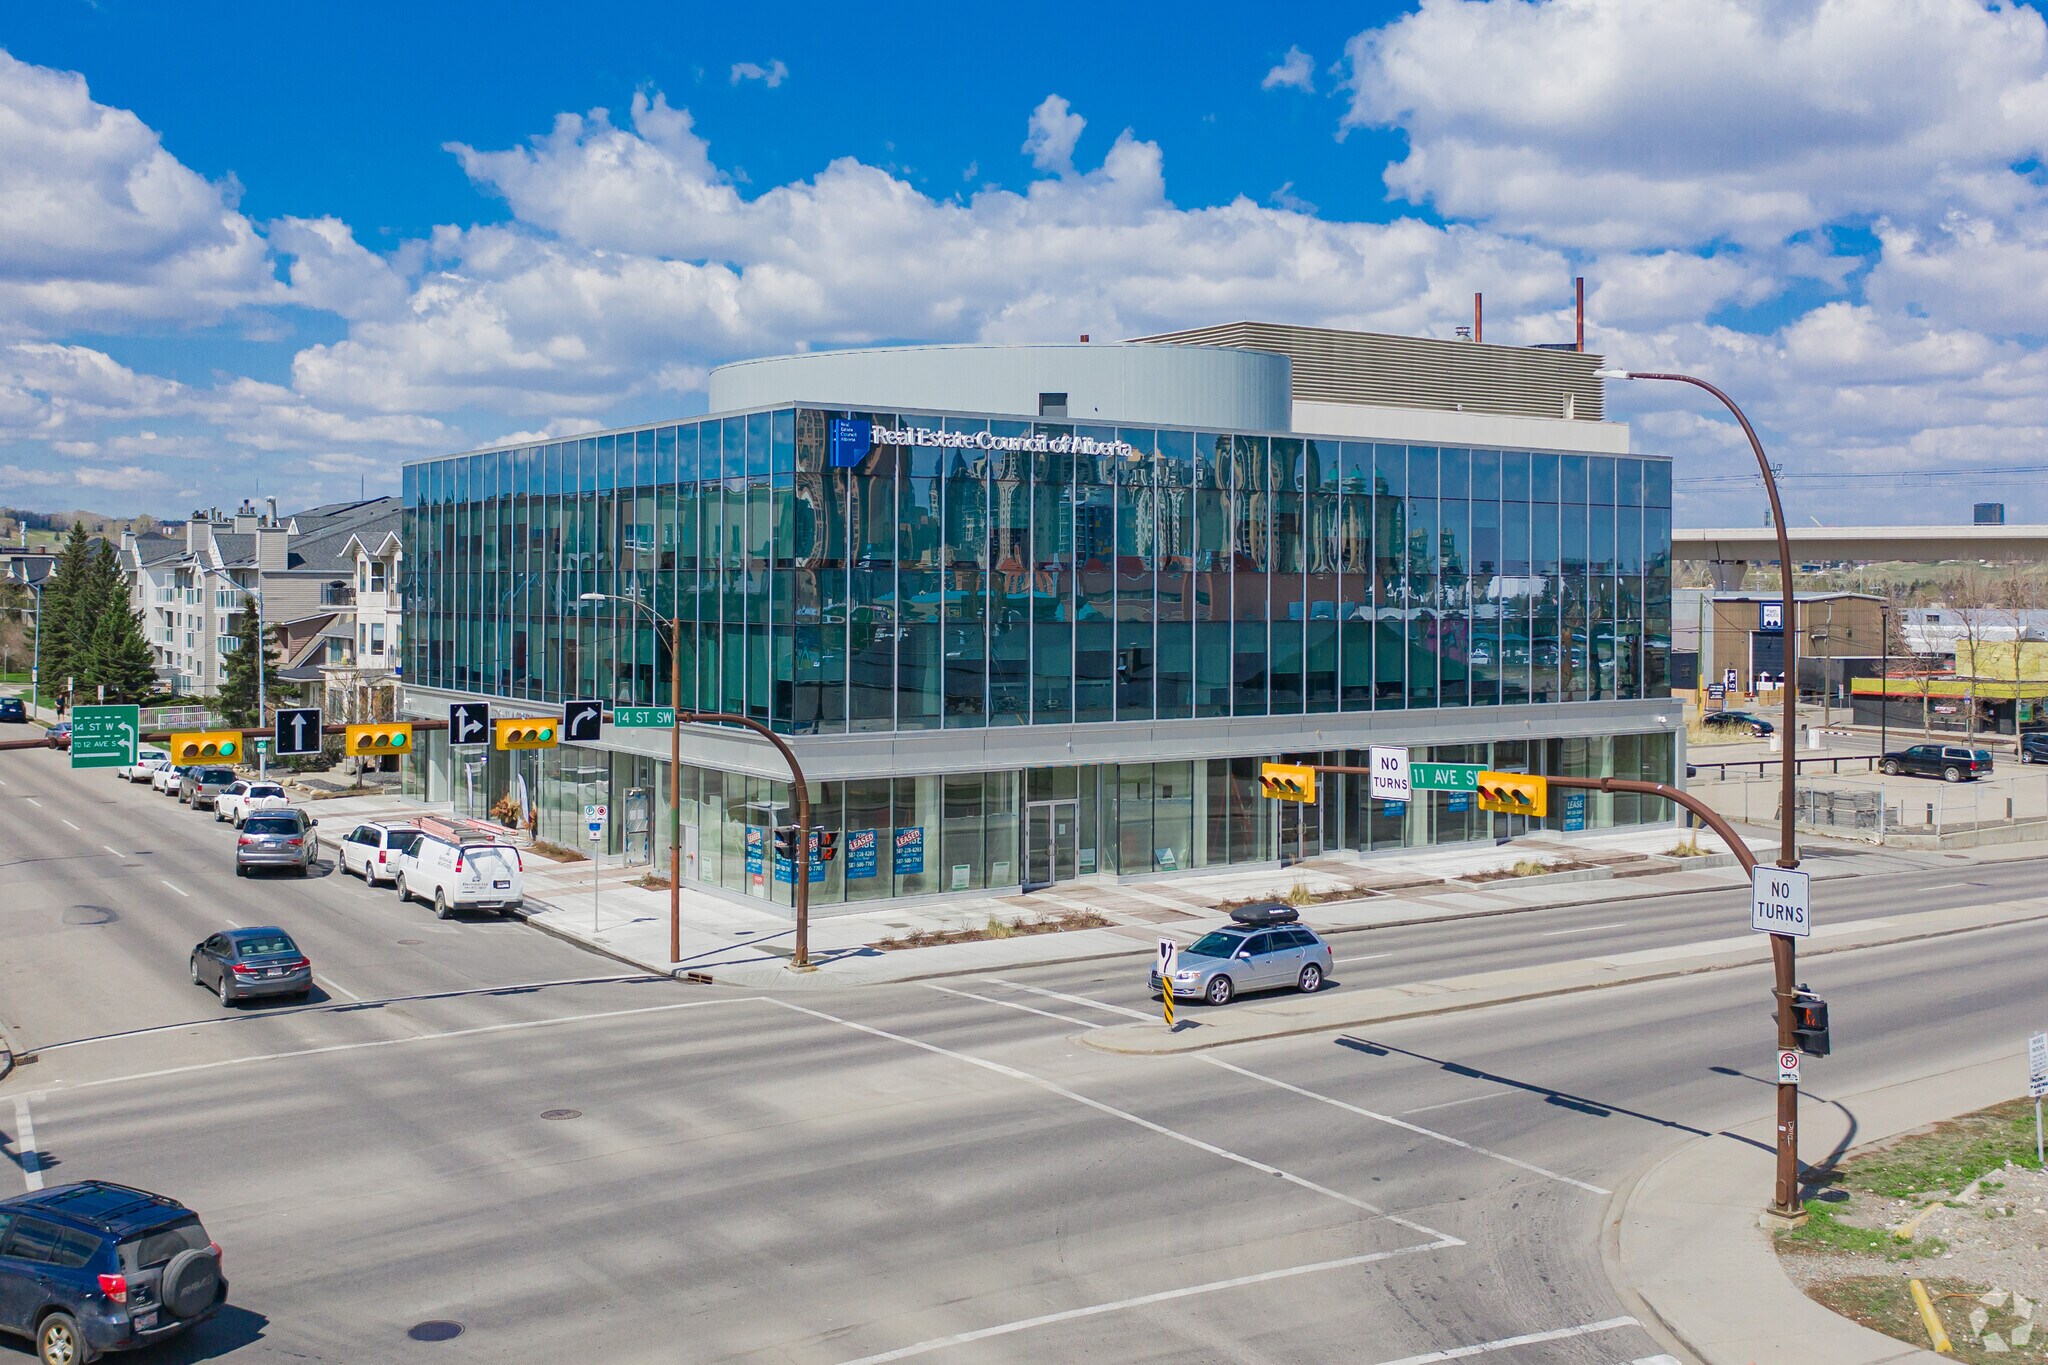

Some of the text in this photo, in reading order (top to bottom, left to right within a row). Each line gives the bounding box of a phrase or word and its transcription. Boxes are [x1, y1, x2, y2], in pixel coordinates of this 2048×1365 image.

[872, 425, 1132, 456] Real Estate Council of Alberta
[617, 712, 672, 723] 14 ST SW
[1381, 757, 1398, 770] NO
[1374, 777, 1408, 789] TURNS
[1414, 769, 1424, 783] 11
[1434, 770, 1458, 785] AVE
[1568, 800, 1582, 809] LEASE
[850, 833, 874, 850] LEASED
[896, 830, 920, 846] LEASED
[1772, 882, 1789, 898] NO
[1758, 902, 1803, 923] TURNS
